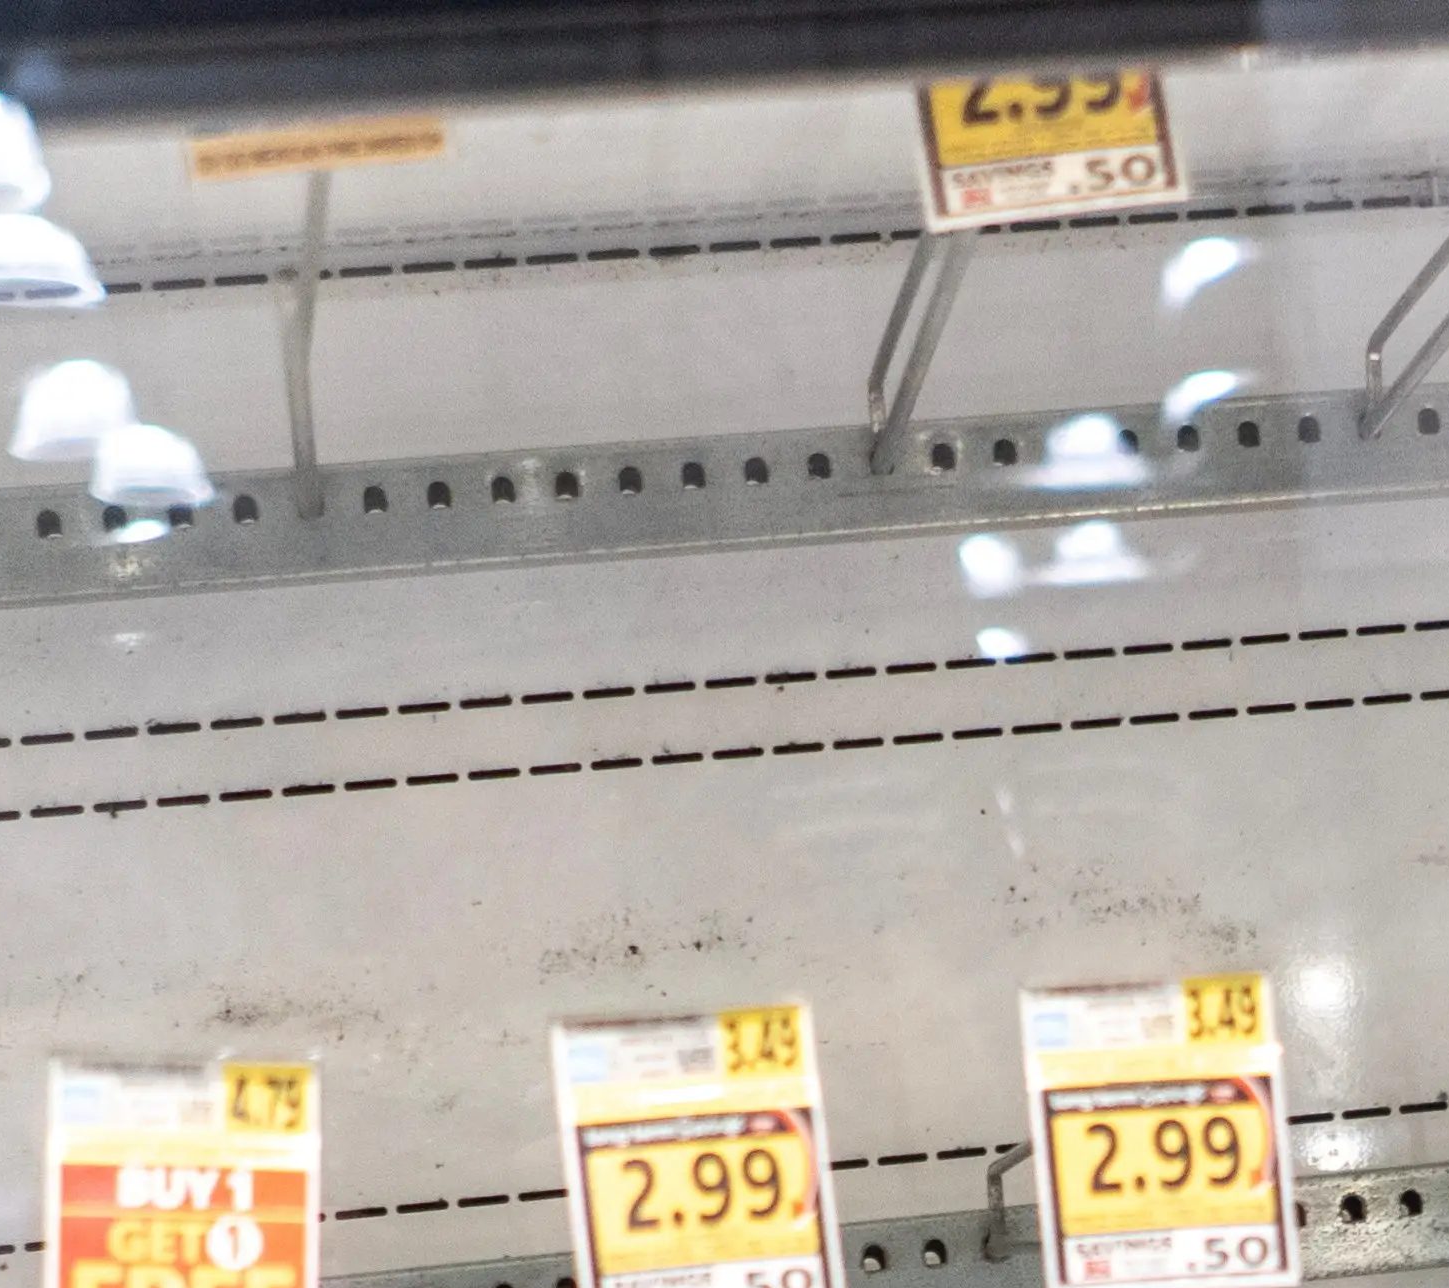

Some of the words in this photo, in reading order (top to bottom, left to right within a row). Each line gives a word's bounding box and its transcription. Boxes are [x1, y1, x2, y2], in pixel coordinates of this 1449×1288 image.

[1067, 156, 1155, 198] .50
[1187, 985, 1257, 1042] 3.49
[727, 1016, 798, 1072] 3.49
[1086, 1116, 1241, 1195] 2.99
[118, 1167, 220, 1210] BUY
[228, 1167, 253, 1210] 1
[622, 1148, 783, 1233] 2.99
[107, 1220, 206, 1265] GET
[1187, 1235, 1269, 1272] .50
